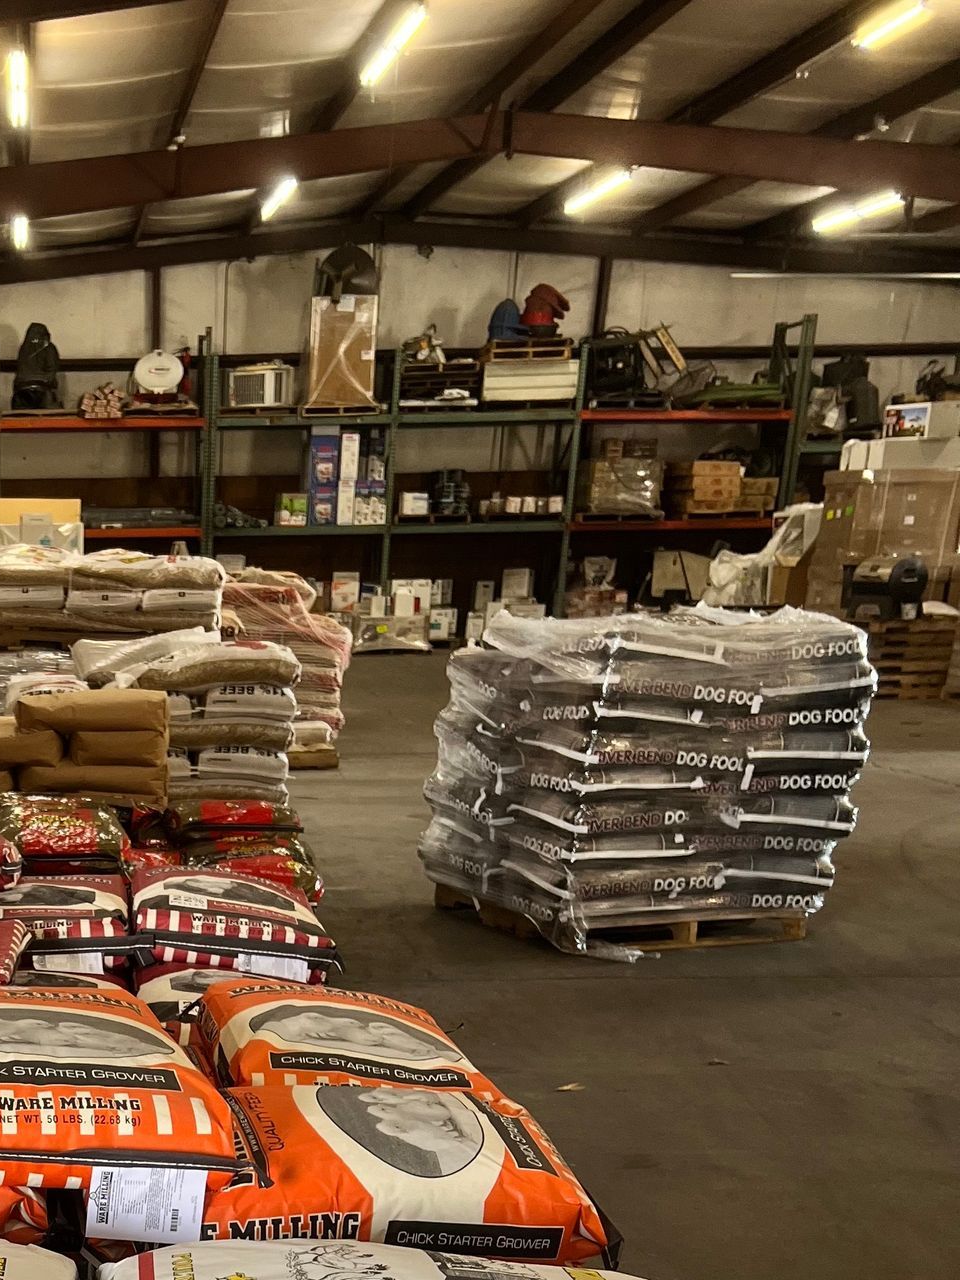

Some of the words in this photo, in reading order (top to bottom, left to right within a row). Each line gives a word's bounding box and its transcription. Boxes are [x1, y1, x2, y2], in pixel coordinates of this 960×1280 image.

[791, 646, 823, 660] DOG
[693, 685, 726, 703] DOG
[788, 710, 822, 726] DOG
[676, 752, 708, 768] DOG
[780, 774, 813, 789] DOG
[763, 836, 794, 851] DOG
[653, 877, 686, 893] DOG
[751, 894, 782, 909] DOG
[11, 1066, 87, 1081] STARTER
[91, 1069, 165, 1084] GROWER
[281, 1056, 325, 1066] CHICK
[329, 1057, 392, 1076] STARTER
[394, 1069, 458, 1084] GROWER
[59, 1097, 142, 1112] MILLING
[0, 1115, 19, 1124] NET
[23, 1115, 43, 1124] WT.
[47, 1115, 58, 1124] 50
[62, 1115, 86, 1124] LBS.
[125, 1114, 141, 1127] kg)
[100, 1170, 113, 1200] MILLING
[97, 1201, 108, 1225] WARE
[228, 1211, 362, 1241] MILLING
[396, 1230, 434, 1245] CHICK
[438, 1231, 493, 1249] STARTER
[496, 1235, 552, 1251] GROWER
